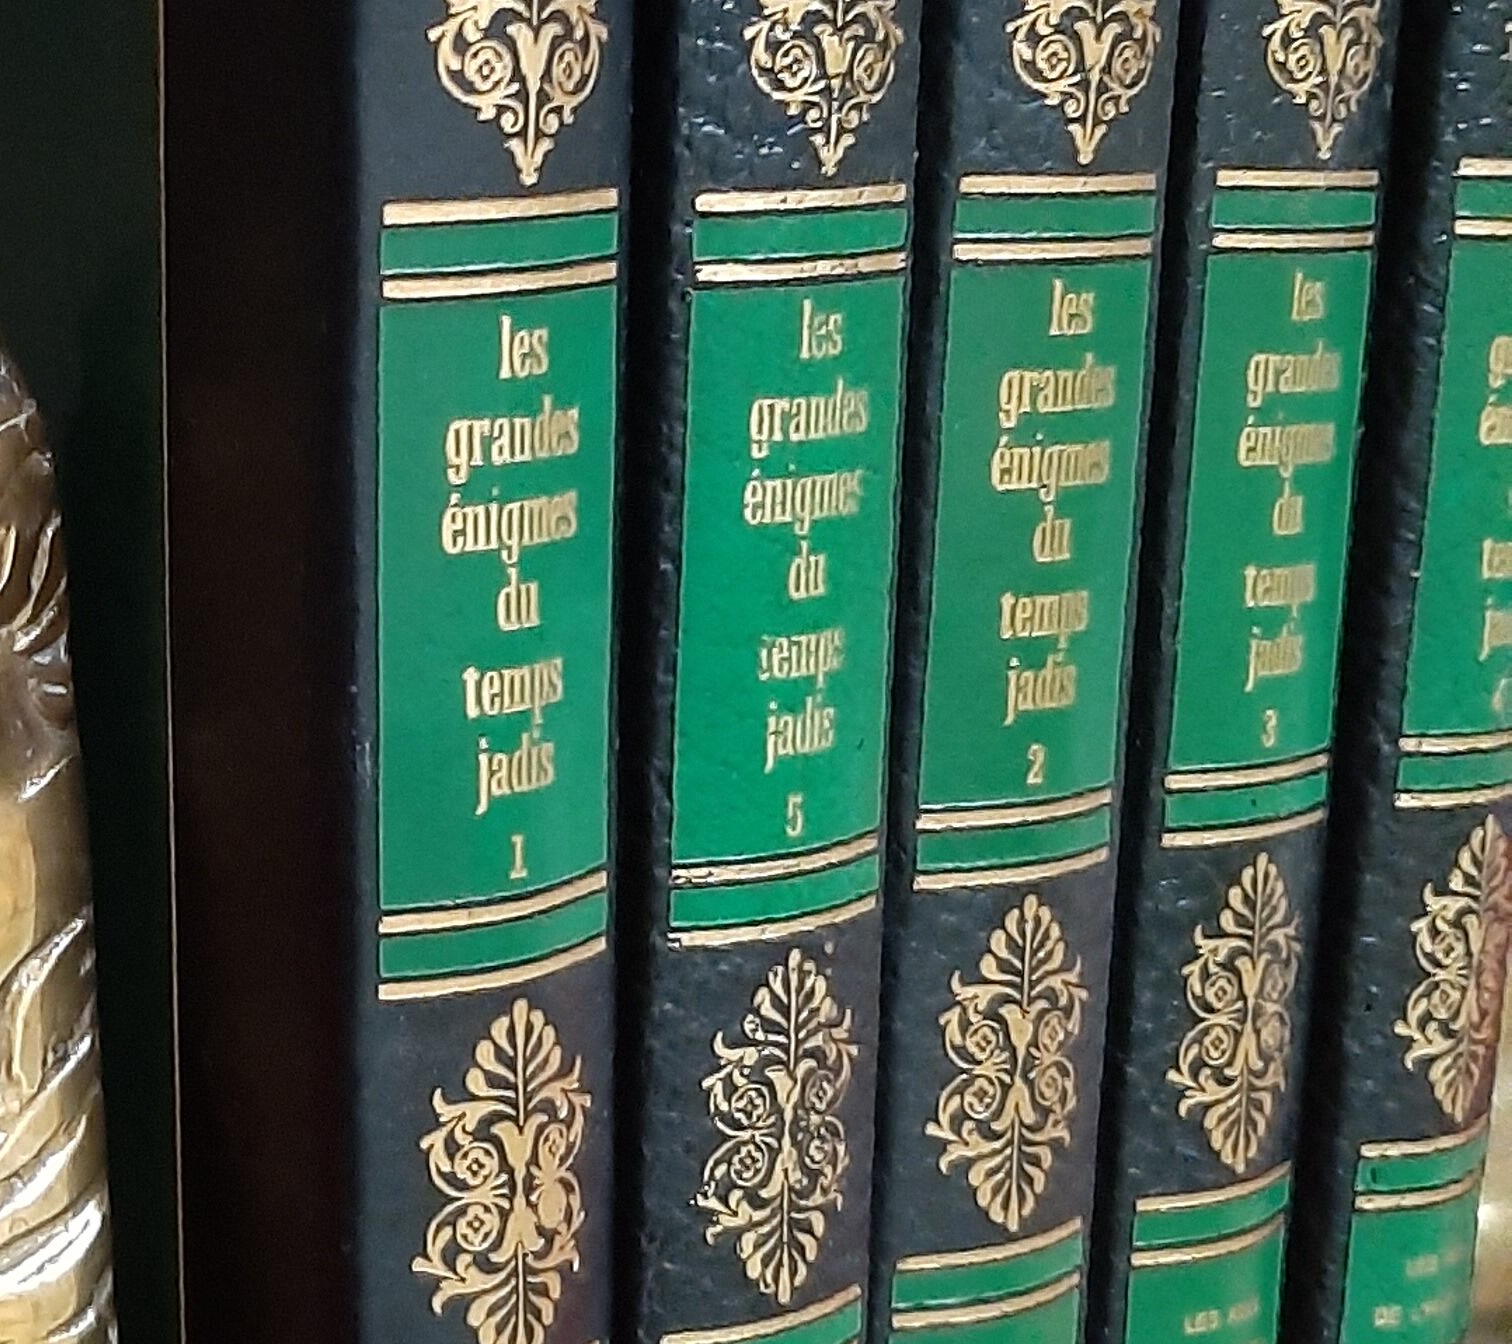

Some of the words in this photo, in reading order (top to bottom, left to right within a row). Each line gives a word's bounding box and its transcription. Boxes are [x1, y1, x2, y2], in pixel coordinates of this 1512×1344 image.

[1049, 279, 1095, 336] les
[1291, 272, 1325, 322] les
[499, 314, 548, 379] les
[799, 298, 843, 359] les
[749, 377, 869, 459] grandes
[999, 352, 1116, 428] grandes
[445, 394, 579, 485] grandes
[441, 489, 577, 564] énigmes
[1033, 505, 1072, 562] du
[1273, 480, 1304, 536] du
[497, 566, 540, 631] du
[789, 539, 826, 600] du
[1000, 590, 1088, 648] temps
[462, 657, 564, 724] temps
[1003, 650, 1076, 726] jadis
[764, 692, 834, 774] jadis
[1262, 709, 1277, 748] 3
[475, 724, 555, 816] jadis
[1026, 743, 1046, 784] 2
[785, 793, 804, 836] 5
[510, 833, 528, 879] 1
